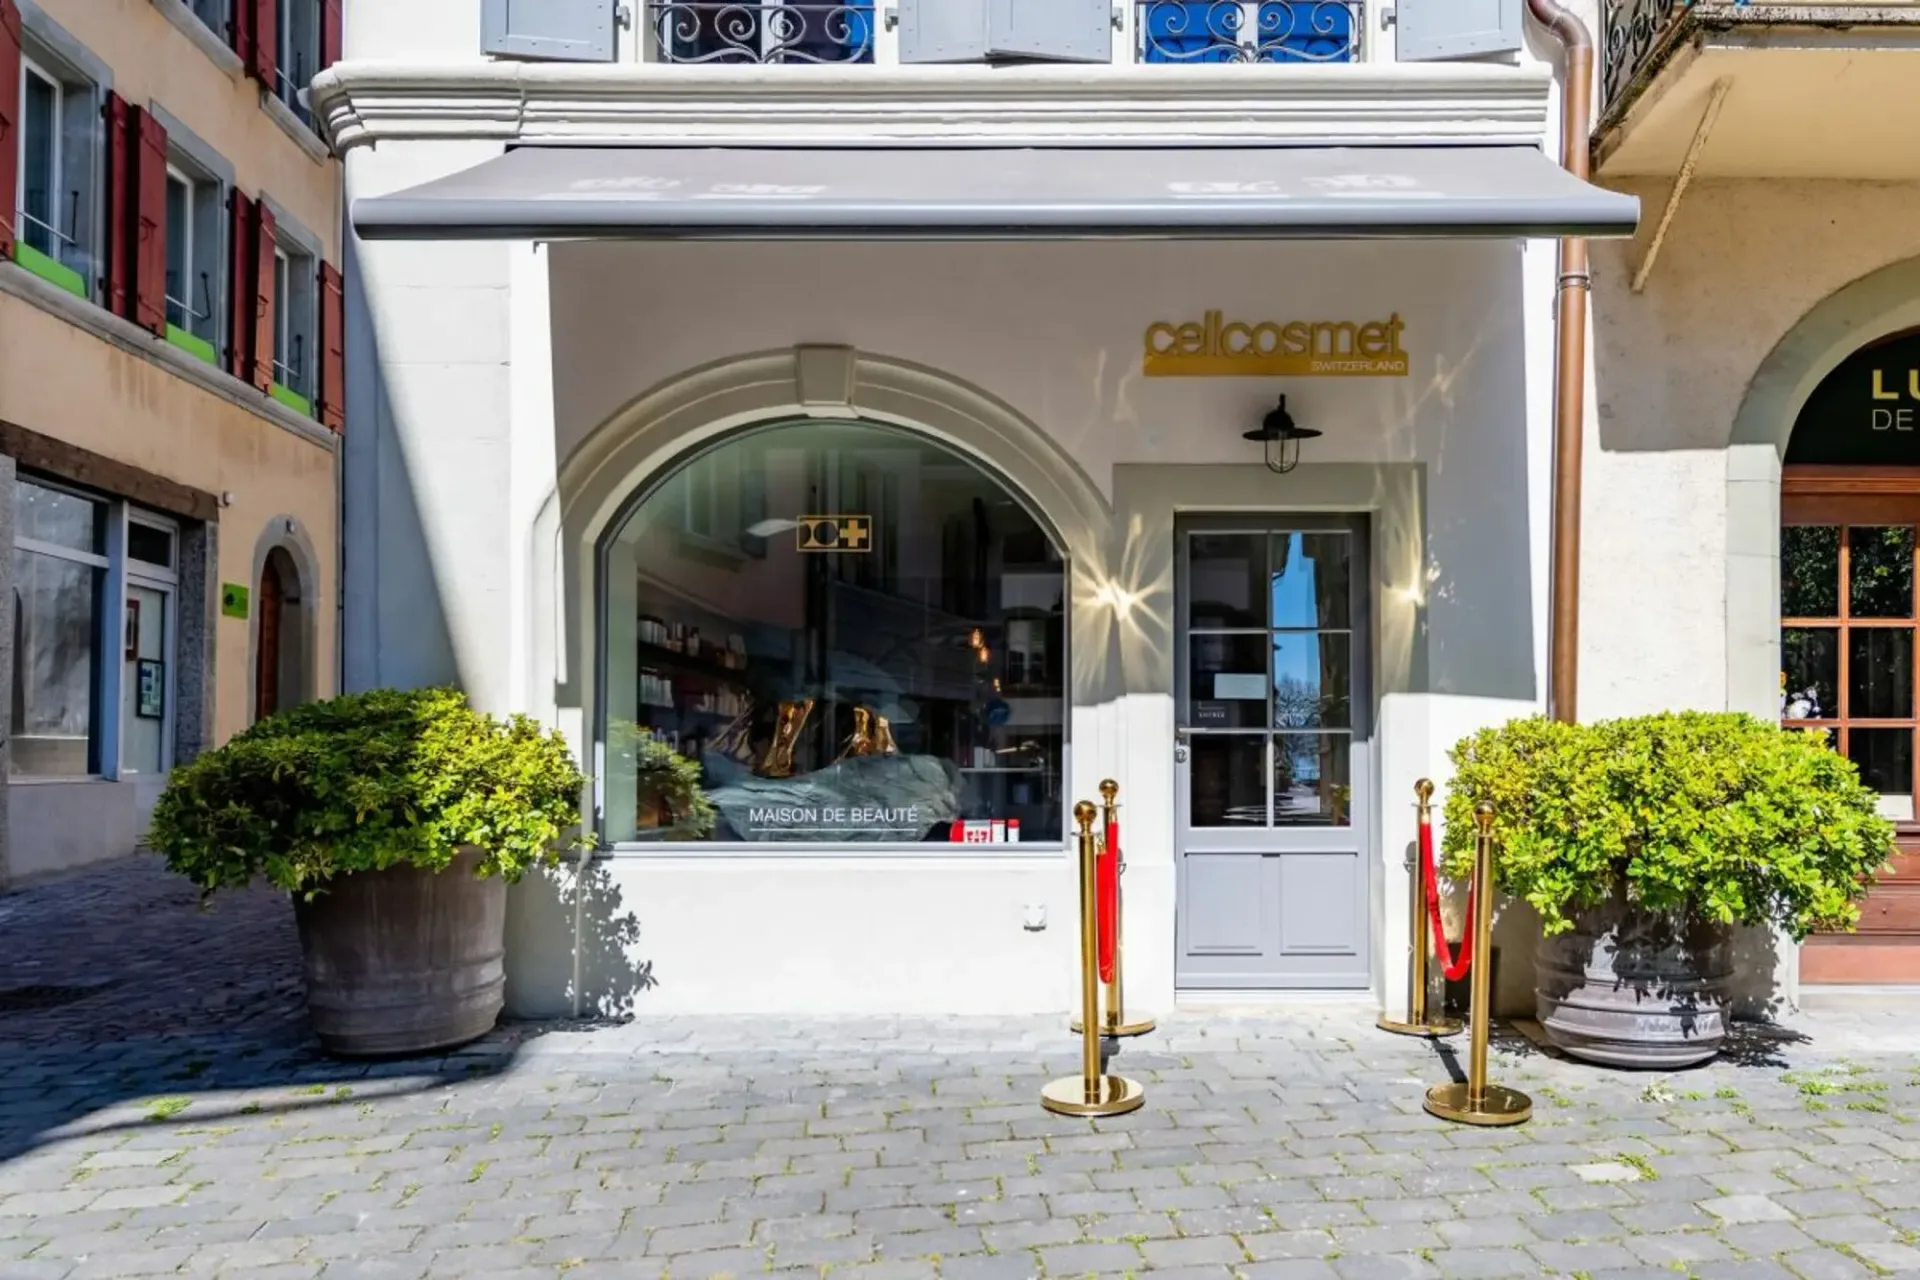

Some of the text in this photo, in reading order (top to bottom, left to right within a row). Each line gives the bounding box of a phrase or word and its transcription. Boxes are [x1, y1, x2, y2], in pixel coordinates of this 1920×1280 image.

[1144, 309, 1406, 358] cellcosmet
[1311, 360, 1406, 372] SWITZERLAND
[1872, 409, 1914, 430] DE
[749, 804, 919, 823] MAISON DE BEAUTÉ
